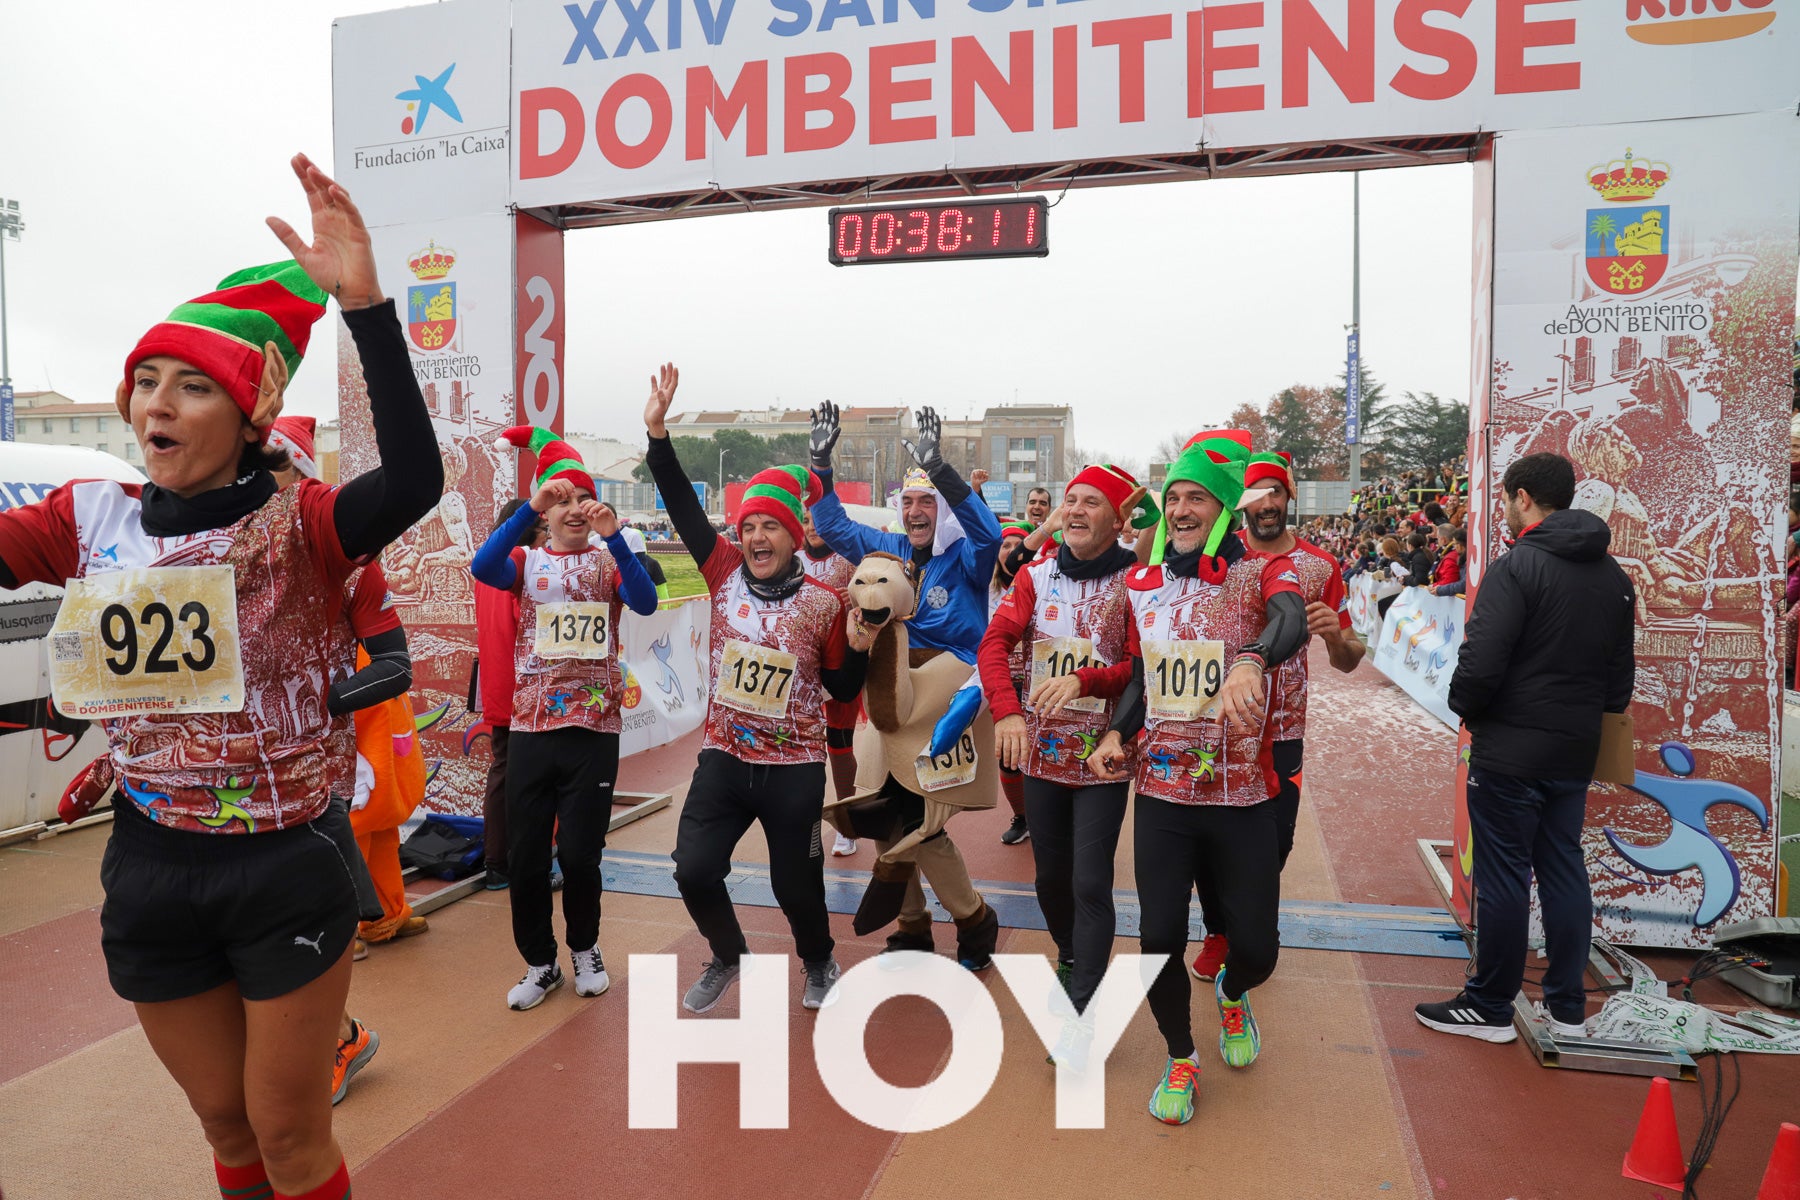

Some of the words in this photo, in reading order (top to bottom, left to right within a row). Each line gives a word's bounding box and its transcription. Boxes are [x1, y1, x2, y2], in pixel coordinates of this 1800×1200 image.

[563, 0, 731, 65] XXIV
[519, 0, 1581, 180] DOMBENITENSE
[354, 144, 436, 169] Fundación
[838, 207, 1035, 256] 00:38:11
[1565, 301, 1704, 322] Ayuntamiento
[1628, 314, 1707, 333] BENITO
[412, 354, 479, 369] untamiento
[434, 363, 481, 380] BENITO
[100, 601, 216, 675] 923
[550, 614, 606, 644] 1378
[733, 657, 793, 698] 1377
[1047, 651, 1108, 678] 101
[1156, 658, 1221, 697] 1019
[79, 701, 175, 714] DOMBENITENSE
